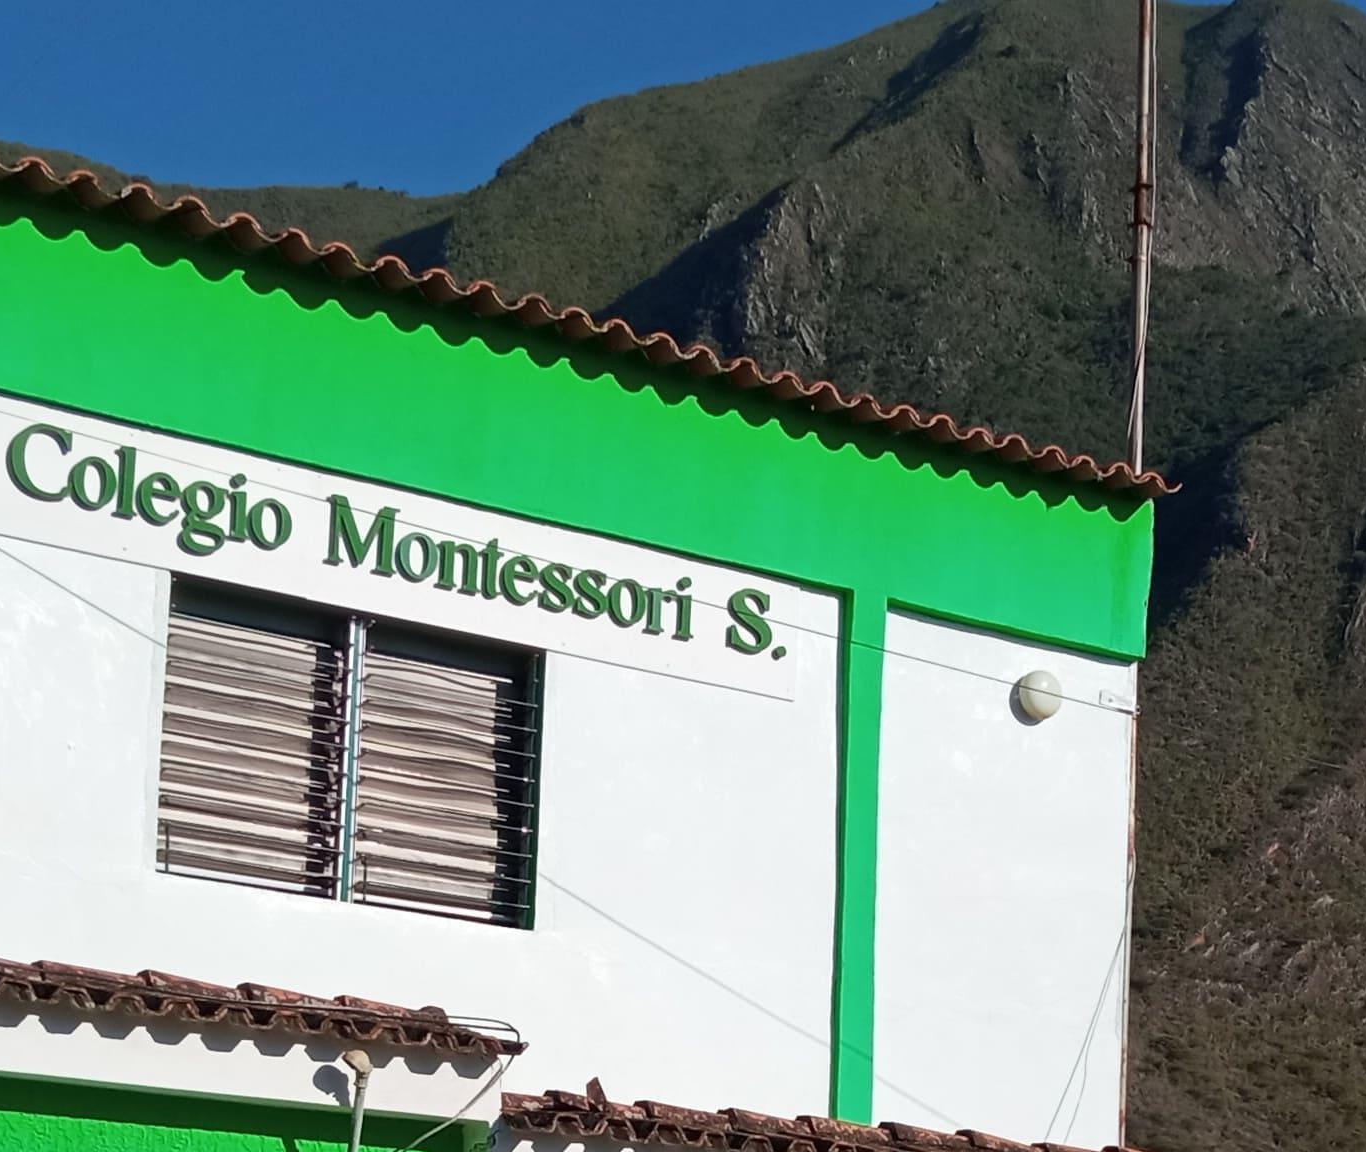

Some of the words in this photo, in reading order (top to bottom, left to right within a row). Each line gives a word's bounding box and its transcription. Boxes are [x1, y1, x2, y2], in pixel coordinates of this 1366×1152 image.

[6, 423, 293, 557] Colegio
[322, 493, 694, 643] Montessori
[725, 588, 789, 662] S.
